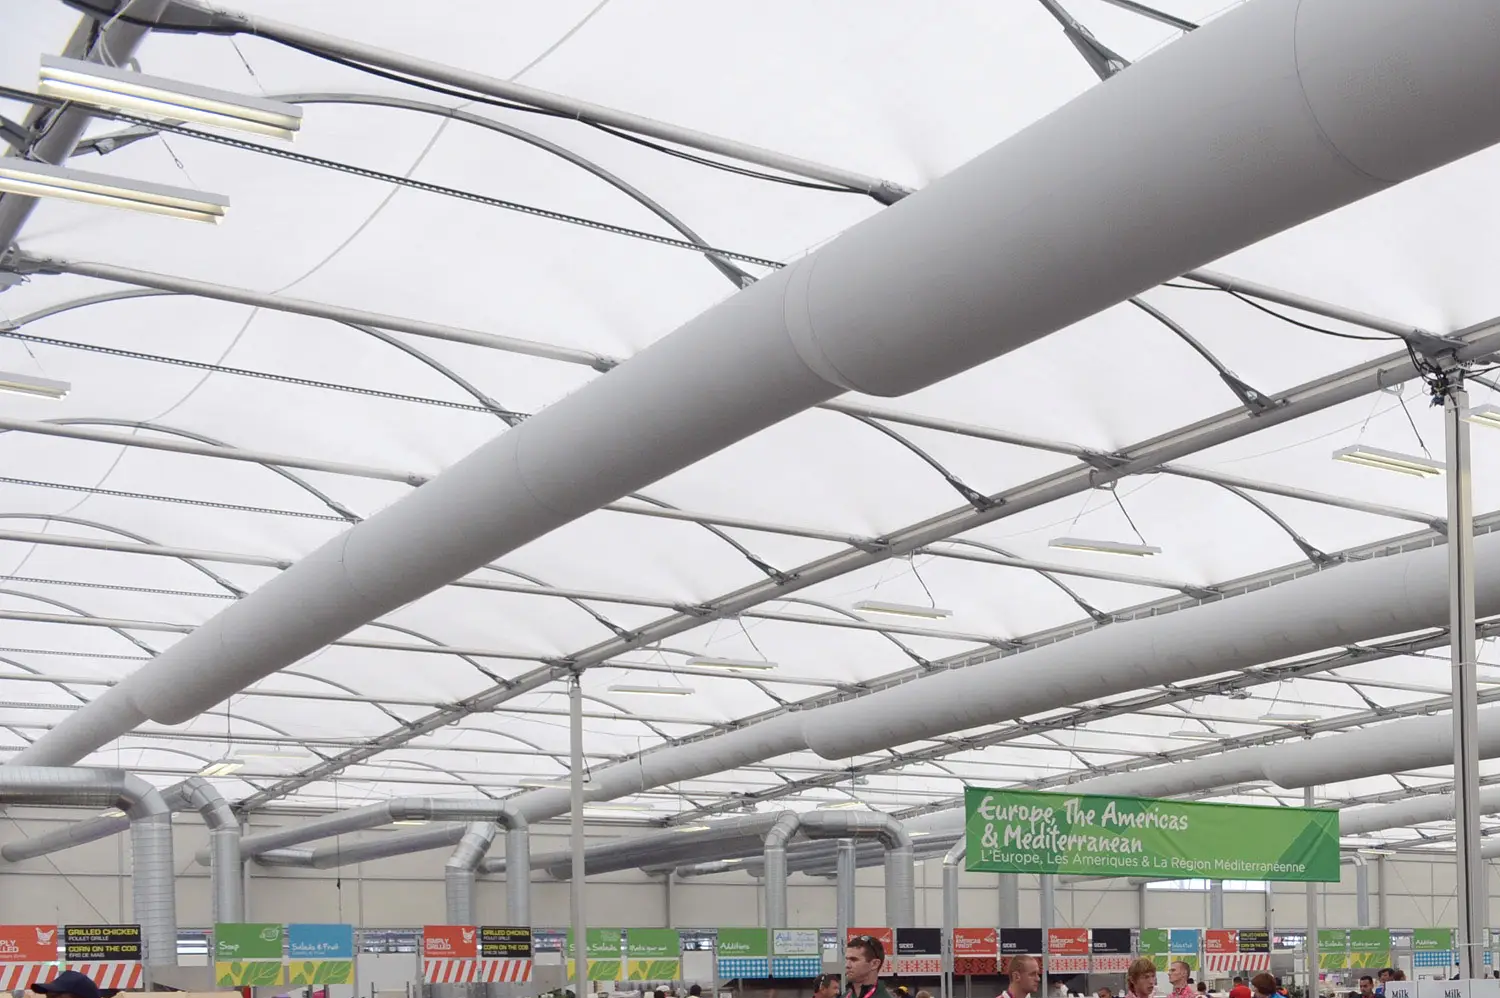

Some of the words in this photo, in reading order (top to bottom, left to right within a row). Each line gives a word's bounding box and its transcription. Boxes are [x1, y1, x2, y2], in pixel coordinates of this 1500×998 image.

[977, 796, 1056, 834] Europe,
[1064, 797, 1096, 827] The
[1101, 801, 1189, 830] Americas
[981, 823, 998, 849] &
[1004, 823, 1143, 854] Mediterranean
[981, 849, 1043, 865] L'Europe,
[1047, 853, 1069, 865] Les
[1141, 855, 1150, 867] &
[1154, 857, 1167, 869] La
[67, 928, 102, 936] GRILLED
[102, 928, 138, 936] CHICKEN
[68, 945, 91, 953] CORN
[92, 945, 104, 953] ON
[219, 941, 240, 952] Soup
[1391, 989, 1409, 998] Milk
[1444, 989, 1462, 998] Milk
